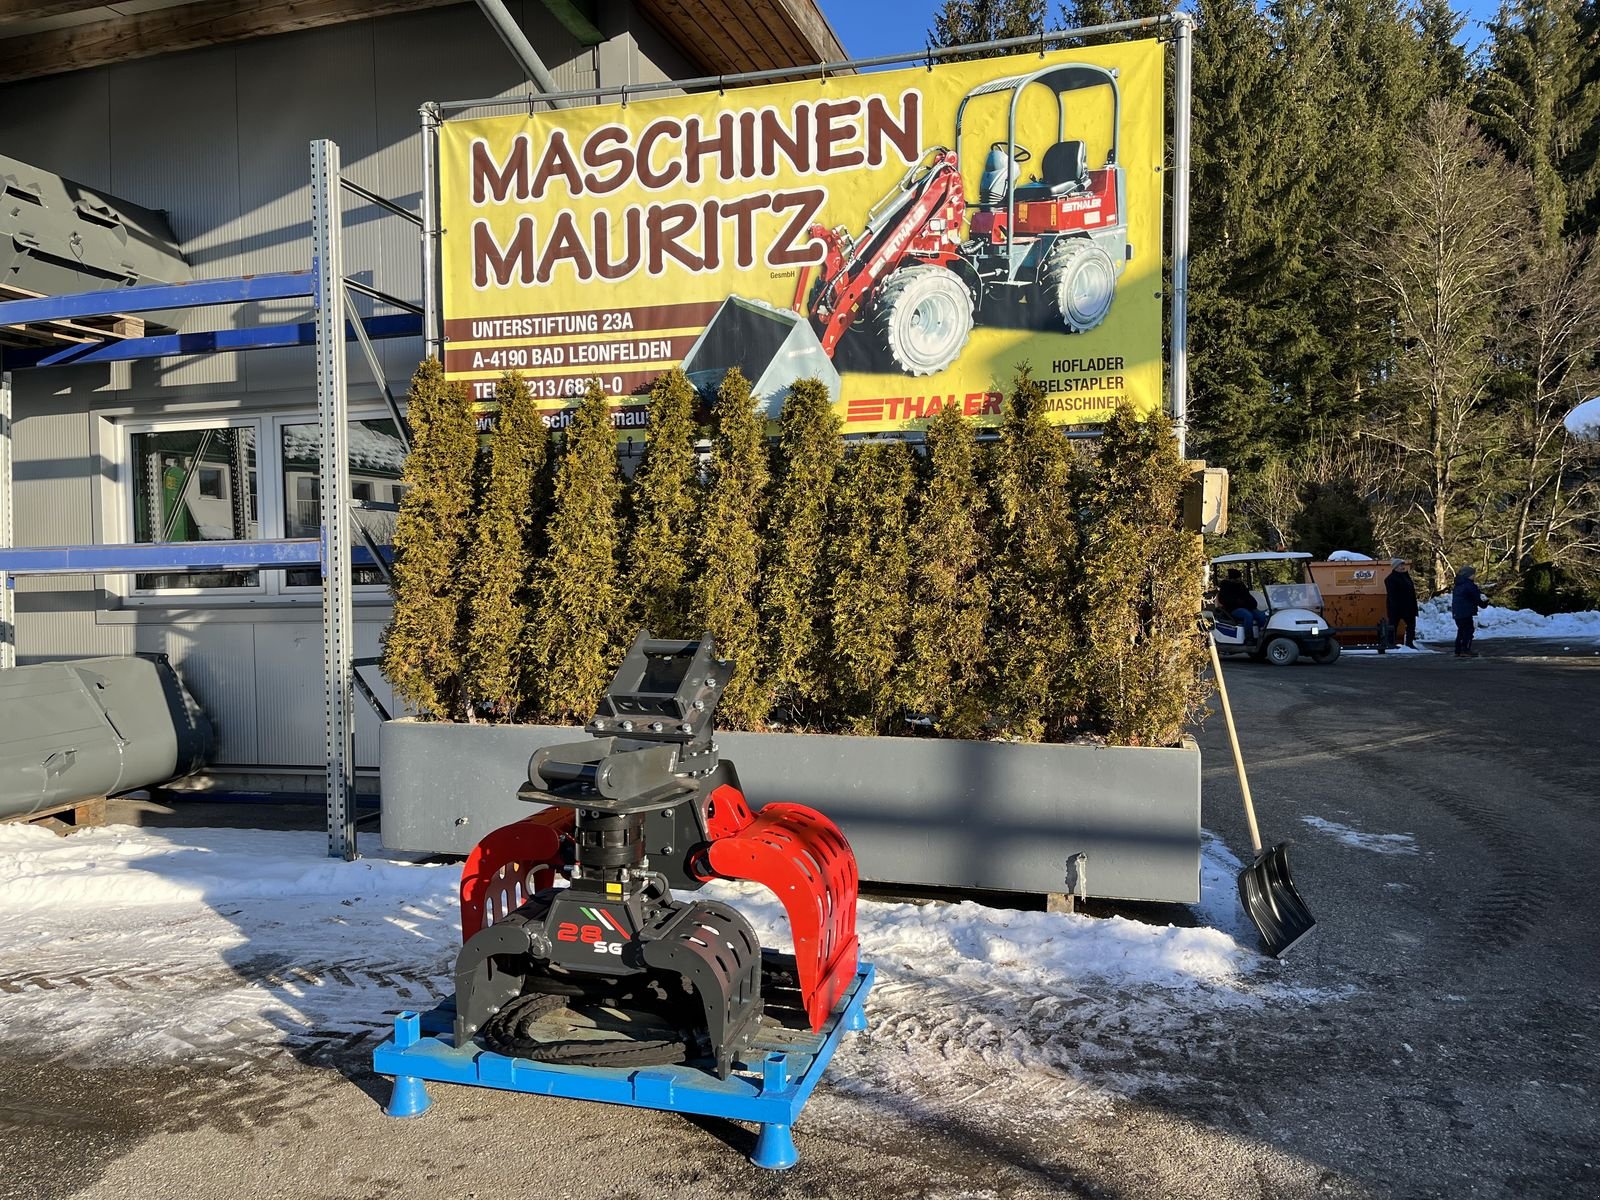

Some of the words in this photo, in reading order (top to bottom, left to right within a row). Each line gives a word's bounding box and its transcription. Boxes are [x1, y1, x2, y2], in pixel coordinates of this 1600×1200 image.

[471, 91, 920, 204] MASCHINEN
[473, 188, 828, 288] MAURITZ
[472, 315, 598, 339] UNTERSTIFTUNG
[602, 312, 634, 331] 23A
[472, 349, 528, 369] A-4190
[532, 346, 564, 366] BAD
[569, 340, 672, 363] LEONFELDEN
[1052, 356, 1124, 374] HOFLADER
[557, 922, 603, 945] 28
[593, 940, 623, 956] SG
